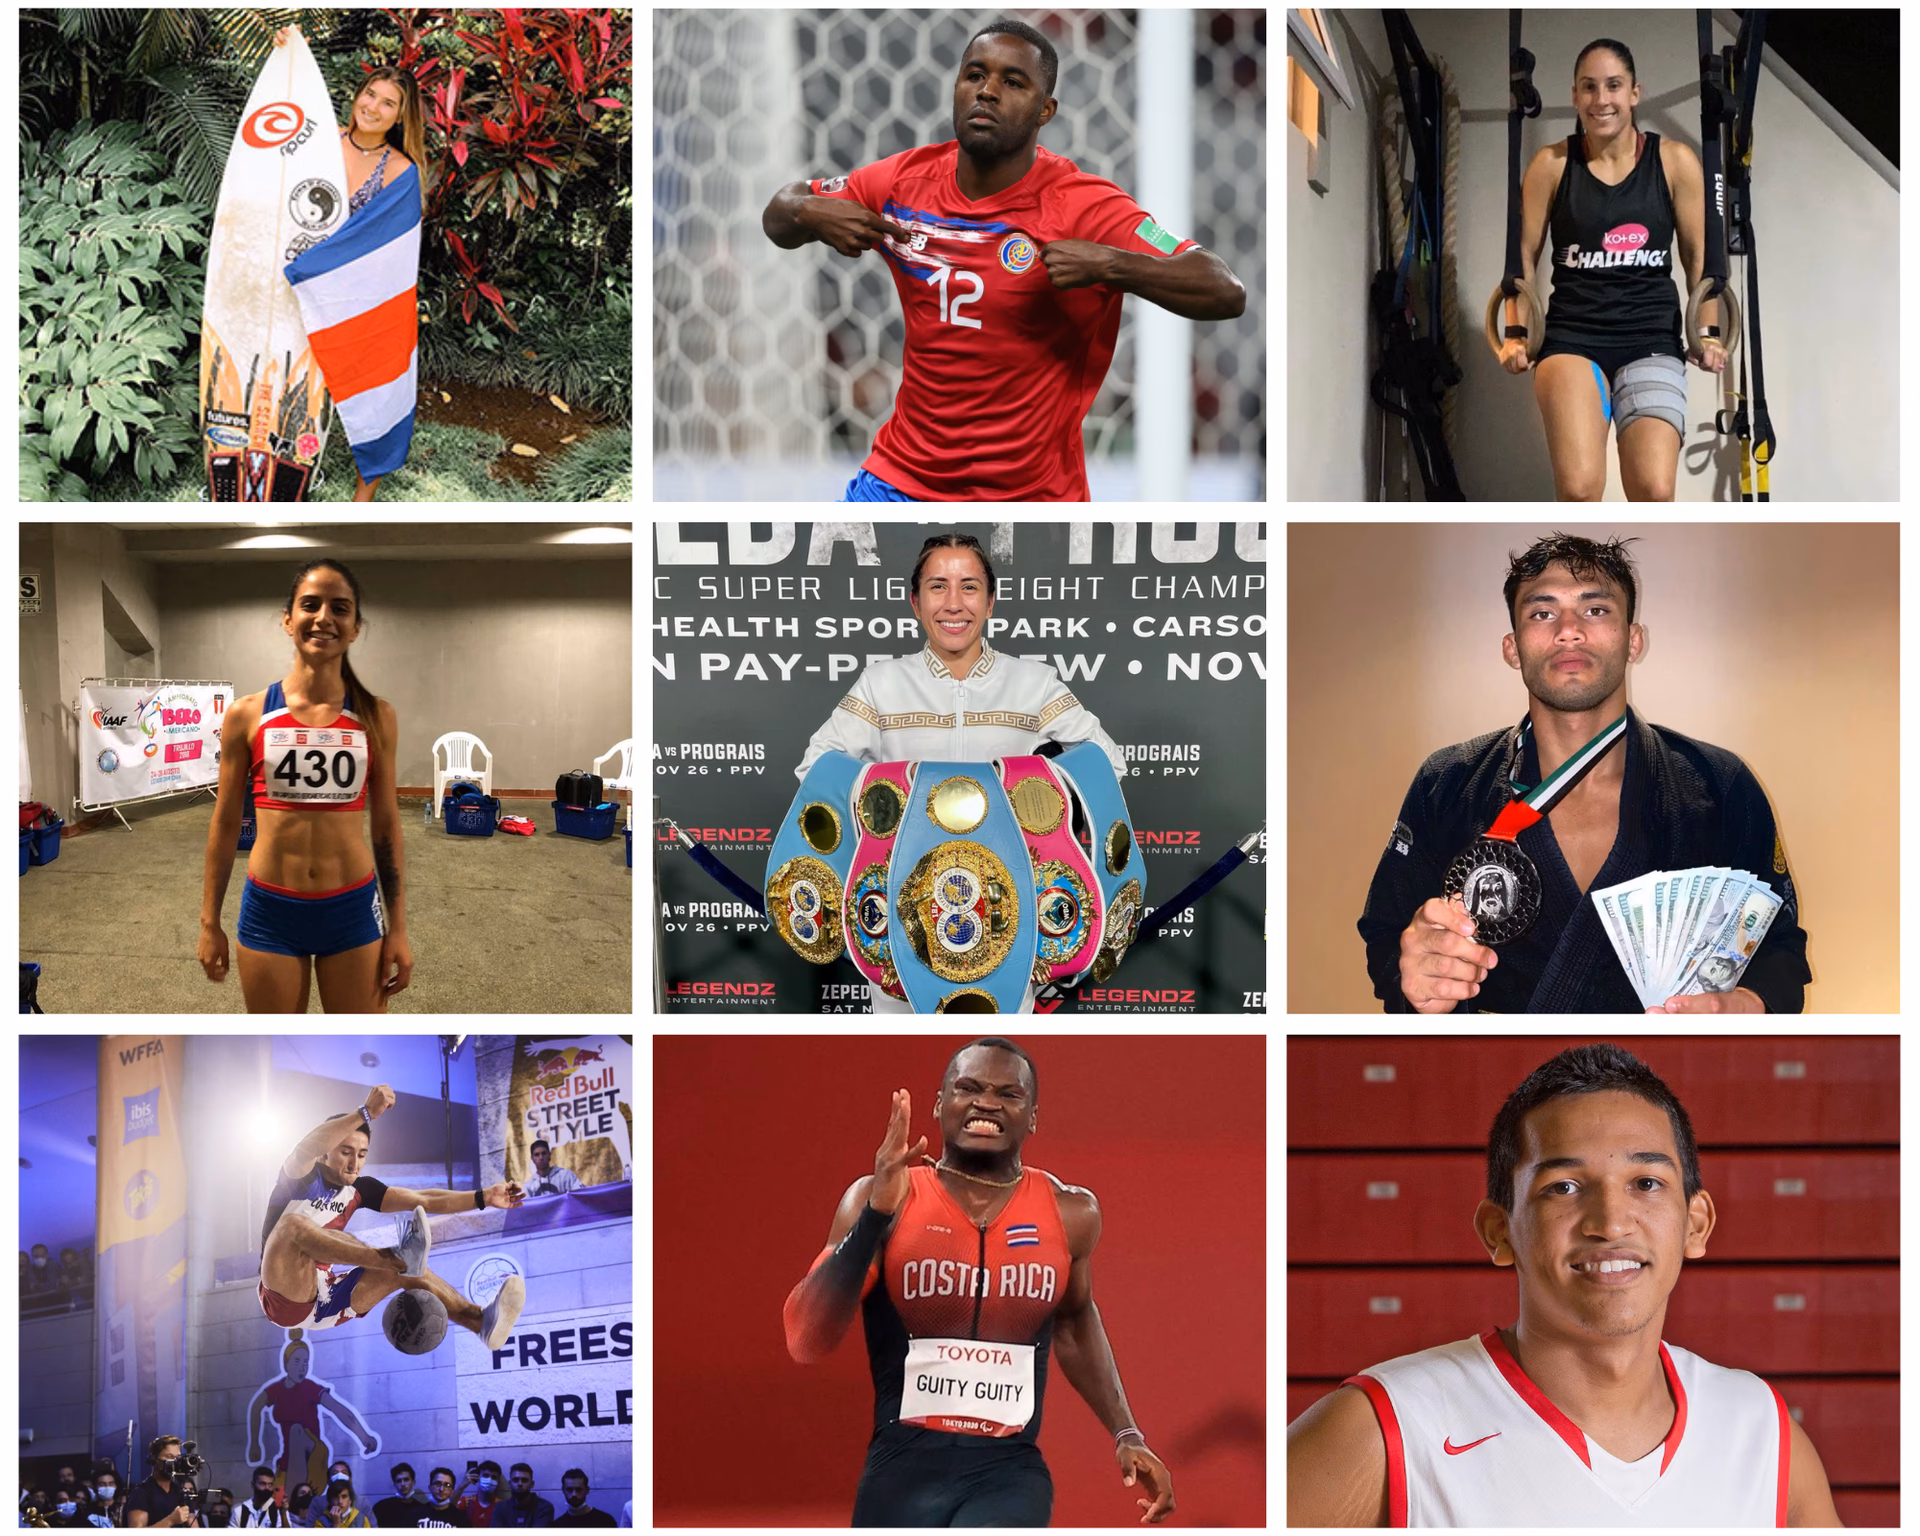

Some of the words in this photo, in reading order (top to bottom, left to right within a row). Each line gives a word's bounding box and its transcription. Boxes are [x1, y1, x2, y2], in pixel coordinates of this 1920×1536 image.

[926, 265, 985, 330] 12
[20, 576, 37, 598] S
[698, 576, 821, 600] SUPER
[987, 617, 1091, 639] PARK
[103, 715, 128, 726] IAAF
[162, 707, 202, 727] IBERO
[680, 743, 766, 761] PROGRAIS
[273, 749, 357, 788] 430
[687, 765, 709, 775] 26
[730, 765, 766, 775] PPV
[1163, 767, 1200, 777] PPV
[863, 905, 871, 922] WBO
[1062, 902, 1070, 921] WBO
[695, 923, 716, 932] 26
[736, 922, 770, 933] PPV
[1158, 928, 1194, 938] PPV
[665, 982, 776, 996] LEGENDZ
[1077, 988, 1196, 1004] LEGENDZ
[821, 1005, 855, 1014] SAT
[1077, 1004, 1197, 1013] ENTERTAINMENT
[119, 1038, 164, 1067] WFFA
[530, 1078, 571, 1106] Red
[573, 1065, 615, 1097] Bull
[130, 1102, 151, 1121] ibis
[526, 1088, 621, 1128] STREET
[535, 1112, 614, 1144] STYLE
[903, 1258, 991, 1300] COSTA
[999, 1262, 1056, 1303] RICA
[937, 1345, 1013, 1366] TOYOTA
[916, 1373, 969, 1398] GUITY
[974, 1381, 1024, 1403] GUITY
[941, 1418, 962, 1428] TOKYO
[962, 1420, 979, 1430] 2020
